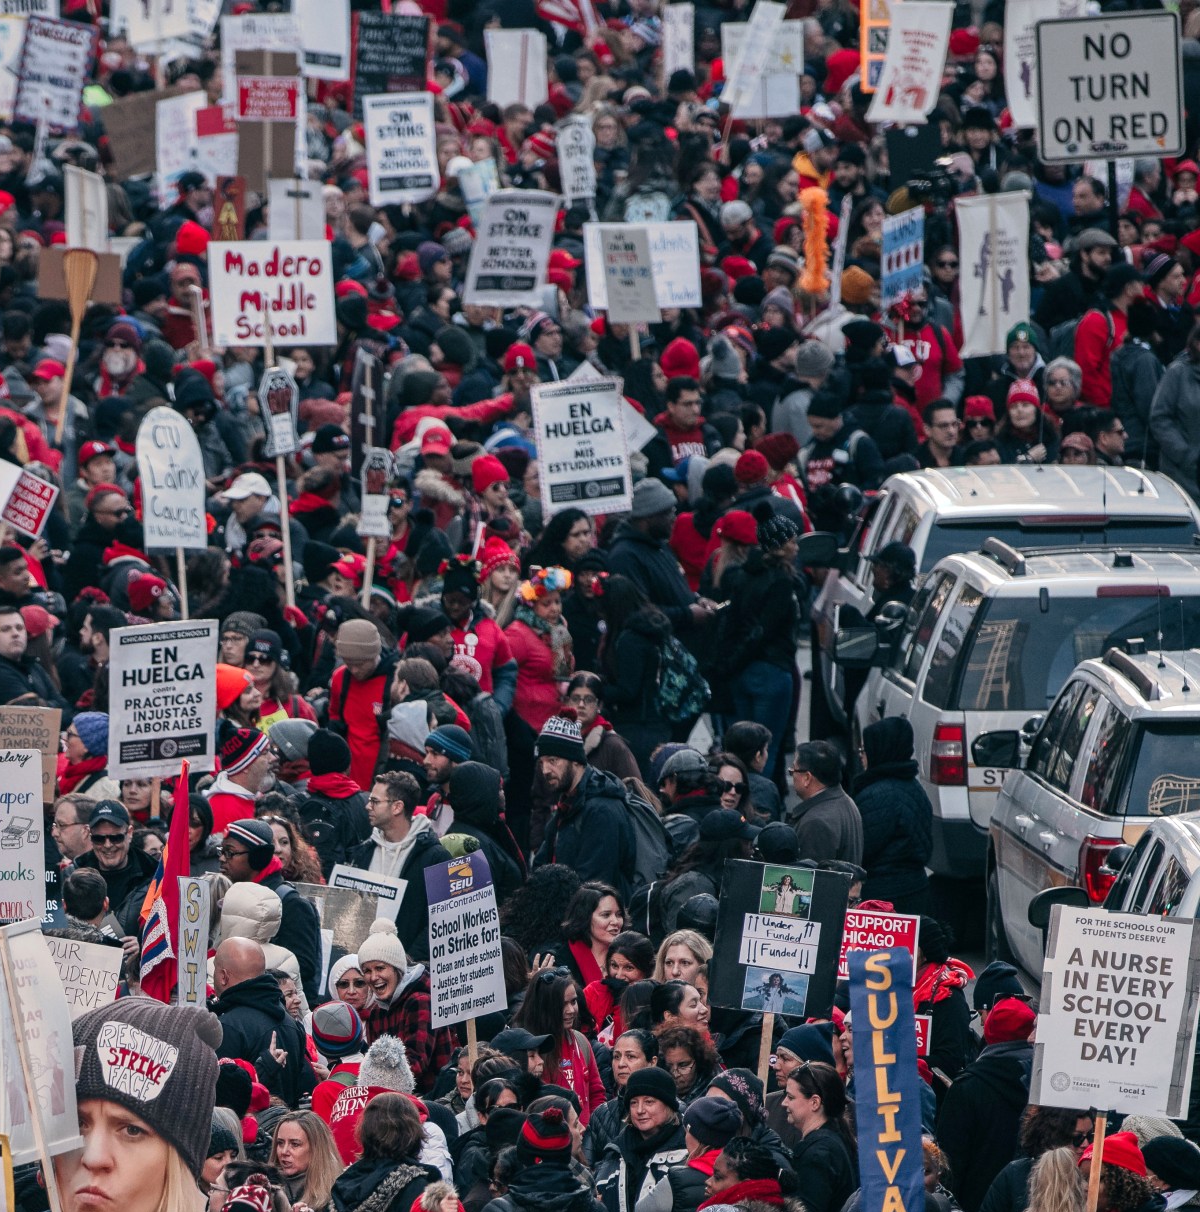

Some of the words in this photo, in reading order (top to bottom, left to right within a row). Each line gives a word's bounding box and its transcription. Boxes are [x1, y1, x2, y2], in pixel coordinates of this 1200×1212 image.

[1083, 33, 1131, 61] NO
[1069, 73, 1150, 102] TURN
[1054, 117, 1094, 145] ON
[1110, 113, 1168, 139] RED
[503, 209, 530, 223] ON
[487, 222, 542, 240] STRIKE
[225, 246, 322, 277] Madero
[488, 246, 532, 260] BETTER
[481, 259, 537, 271] SCHOOLS
[240, 282, 316, 313] Middle
[569, 401, 592, 418] EN
[545, 417, 615, 438] HUELGA
[574, 447, 595, 458] MIS
[149, 454, 199, 490] Latinx
[548, 456, 623, 474] ESTUDIANTES
[153, 496, 200, 528] Caucus
[151, 647, 178, 664] EN
[122, 664, 205, 687] HUELGA
[124, 692, 203, 711] PRACTICAS
[133, 707, 197, 722] INJUSTAS
[126, 718, 202, 735] LABORALES
[3, 737, 49, 749] TAMBIÉN
[448, 859, 462, 868] LOCAL
[449, 877, 473, 892] SEIU
[430, 889, 493, 915] #FairContractNow
[431, 915, 461, 940] School
[462, 907, 497, 931] Workers
[846, 915, 911, 933] SUPPORT
[1076, 917, 1095, 927] FOR
[1098, 918, 1115, 928] THE
[1117, 920, 1153, 931] SCHOOLS
[1156, 923, 1176, 934] OUR
[447, 932, 478, 954] Strike
[766, 929, 802, 944] Funded
[843, 930, 895, 947] HICAGO
[1082, 928, 1128, 940] STUDENTS
[1131, 932, 1166, 944] DESERVE
[760, 943, 798, 960] Funded
[1068, 947, 1084, 965] A
[1091, 950, 1174, 976] NURSE
[54, 958, 118, 991] TUDENTS
[1063, 969, 1089, 990] IN
[1096, 972, 1174, 998] EVERY
[1063, 993, 1167, 1023] SCHOOL
[1074, 1018, 1151, 1044] EVERY
[99, 1024, 179, 1066] RESTING
[1080, 1042, 1137, 1066] DAY!
[107, 1047, 169, 1086] STRIKE
[109, 1065, 155, 1101] FACE
[1073, 1080, 1100, 1089] TEACHERS
